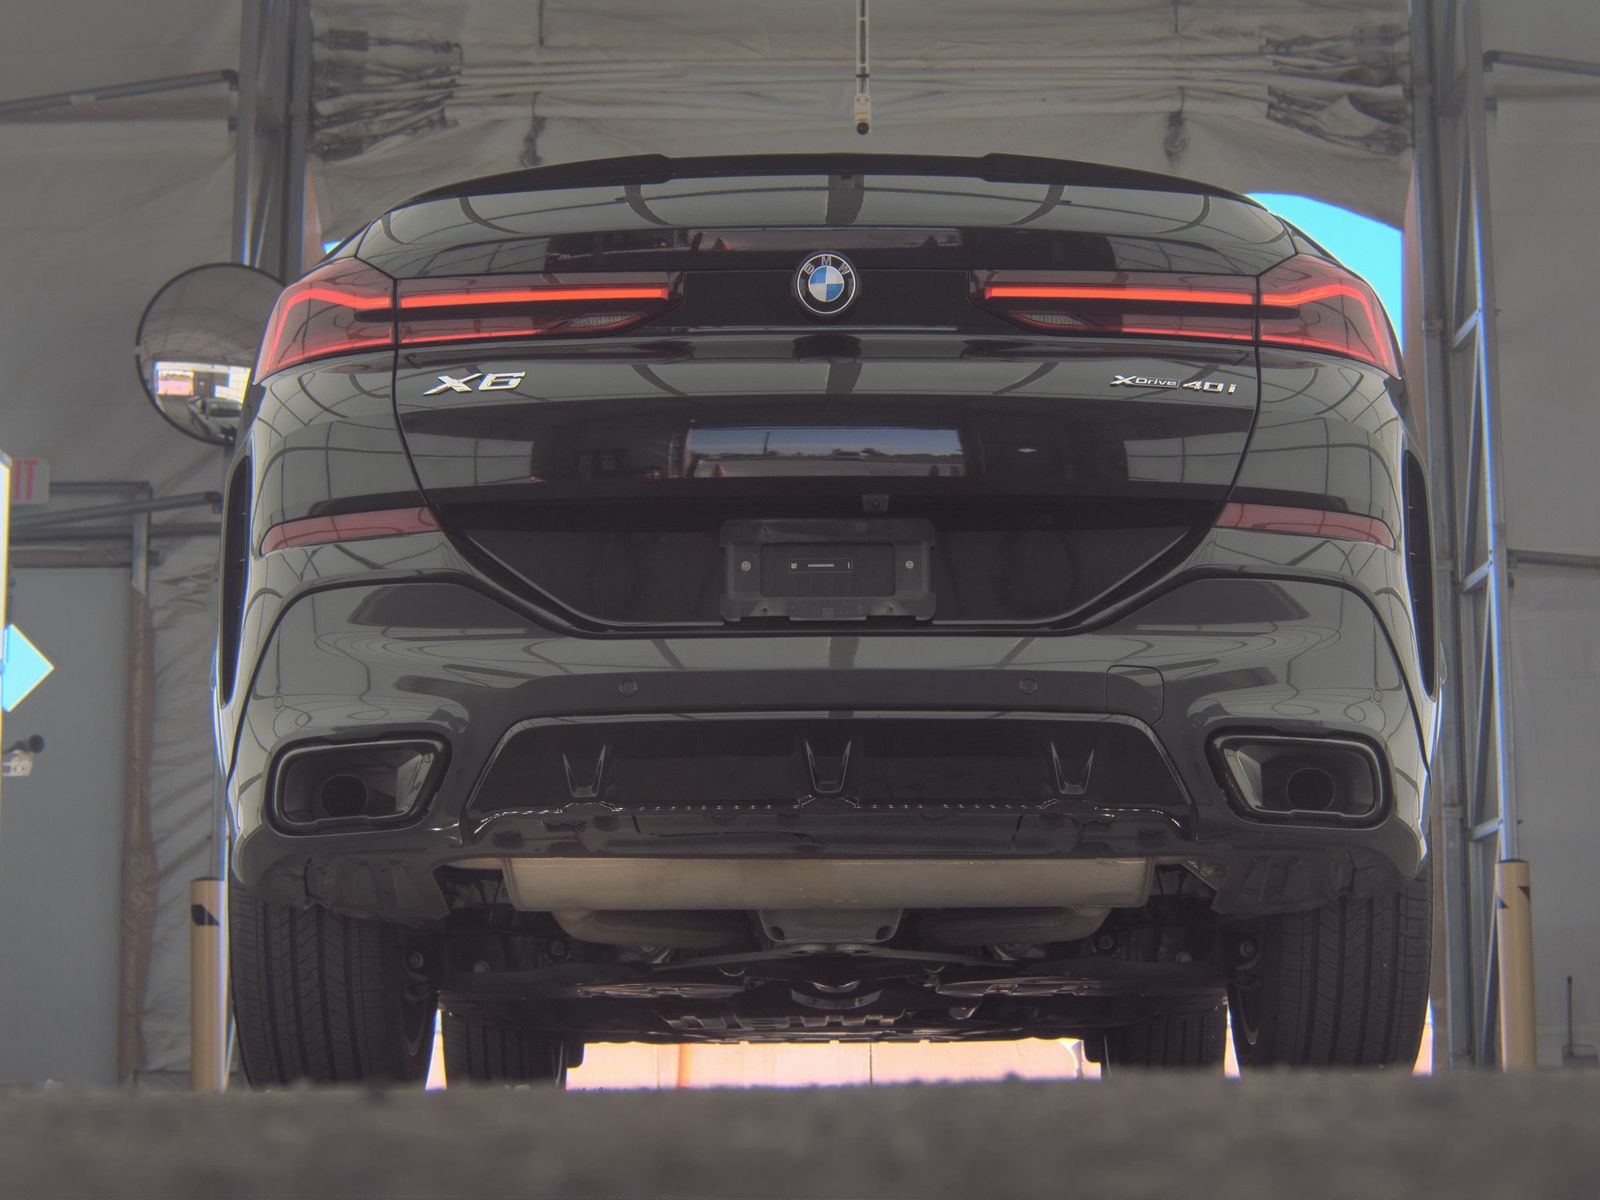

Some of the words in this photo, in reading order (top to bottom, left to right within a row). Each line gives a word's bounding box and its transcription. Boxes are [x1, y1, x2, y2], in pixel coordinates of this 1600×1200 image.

[803, 256, 851, 275] BMW
[422, 372, 526, 396] X6
[15, 459, 38, 502] IT
